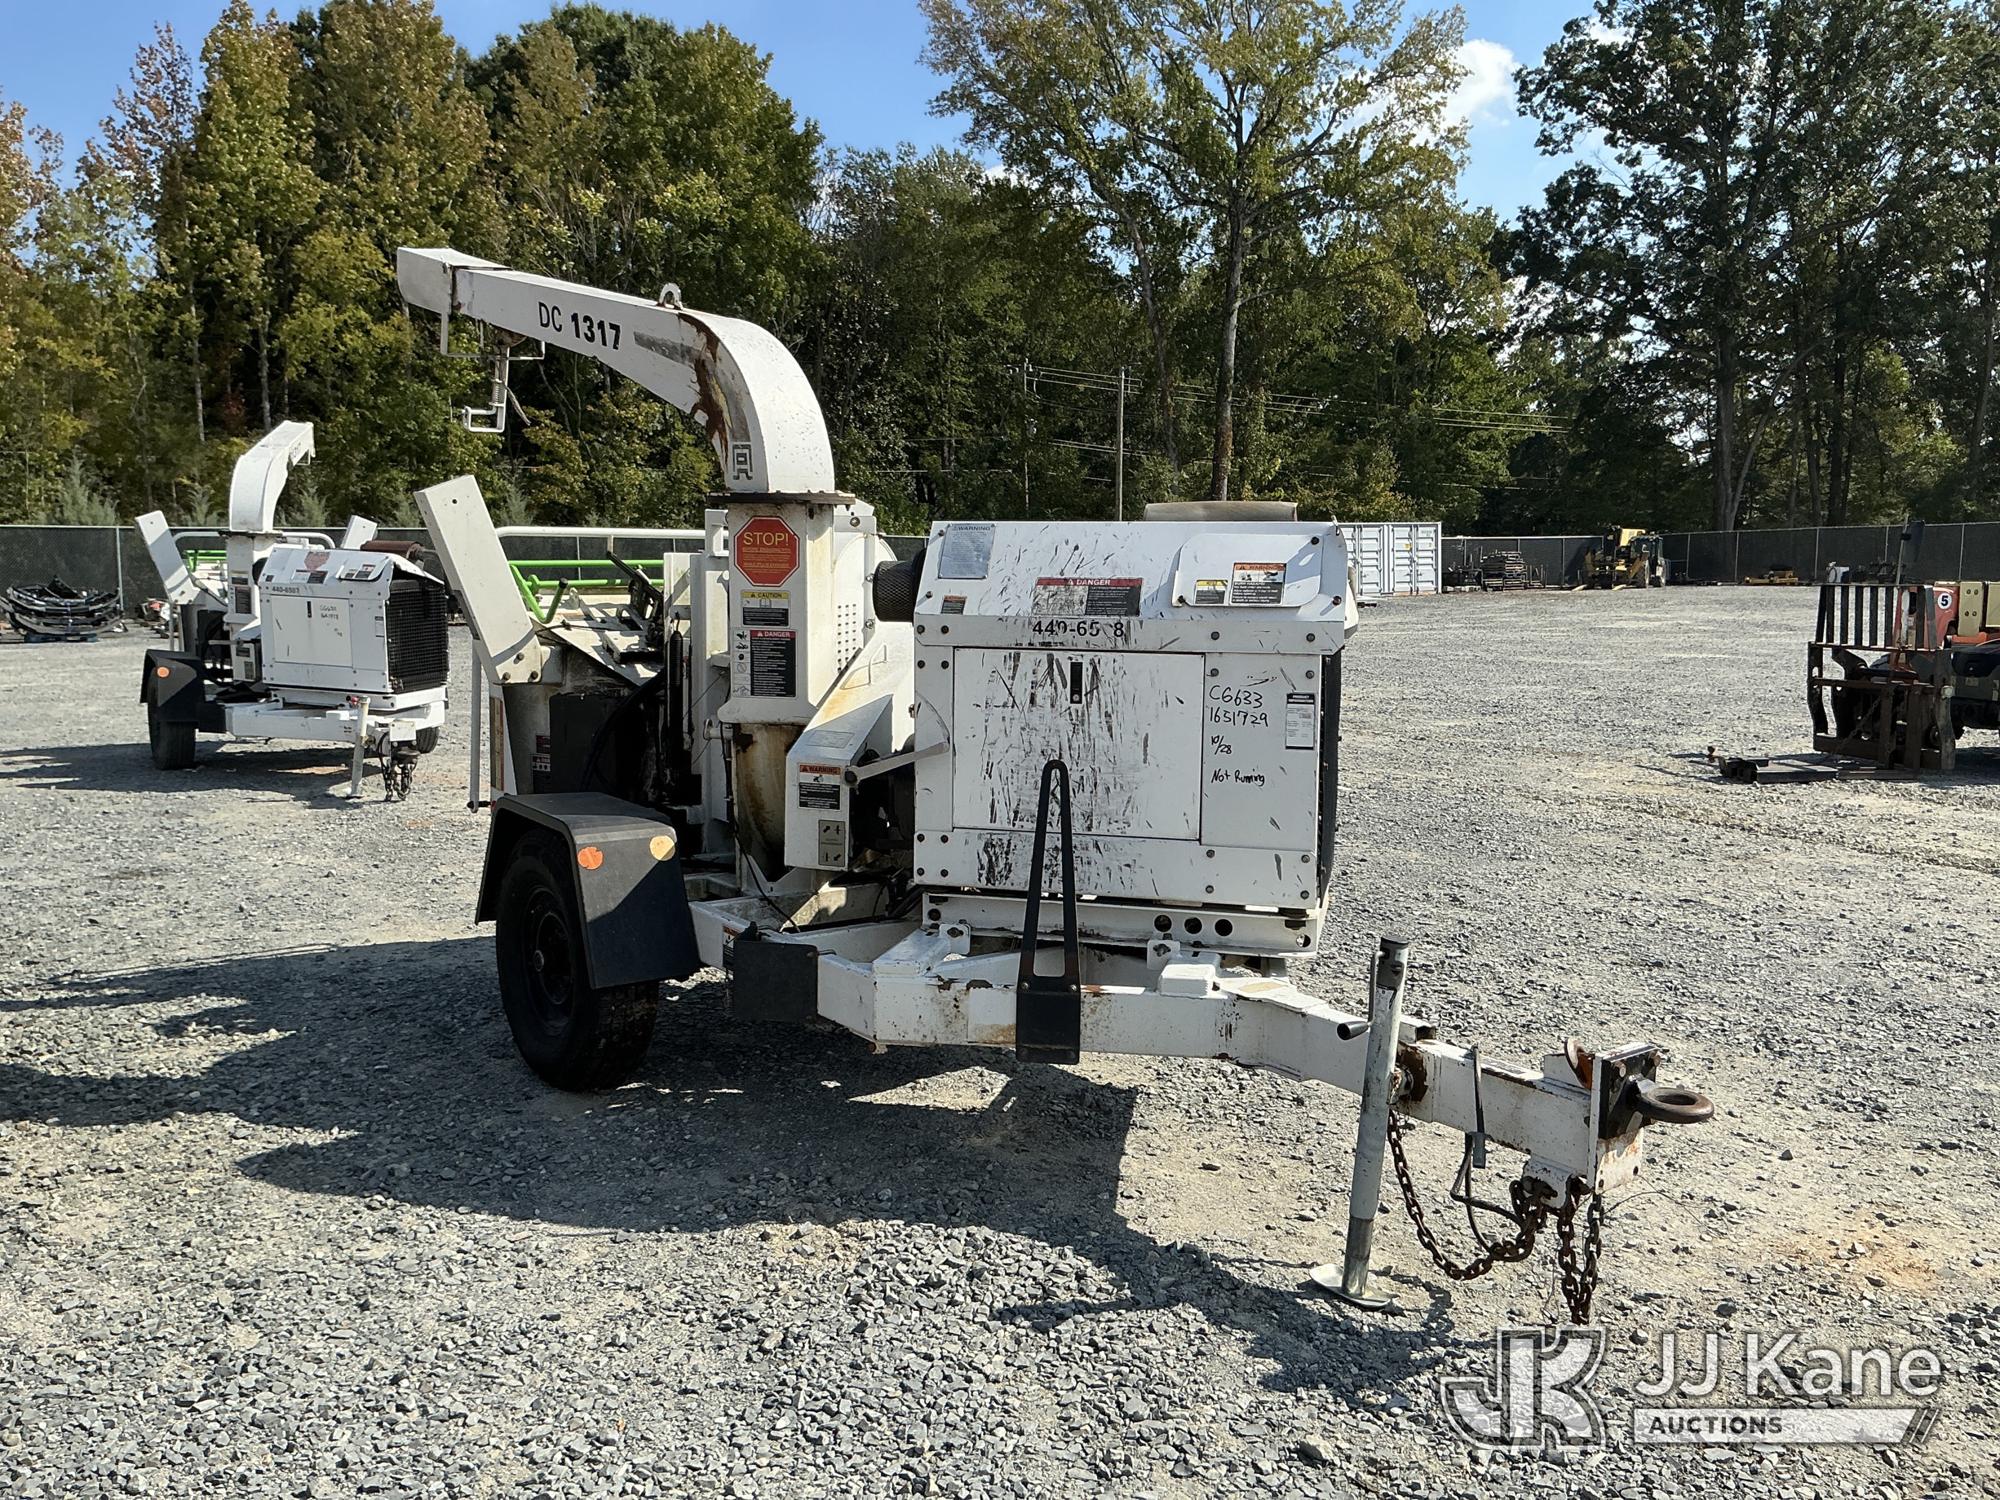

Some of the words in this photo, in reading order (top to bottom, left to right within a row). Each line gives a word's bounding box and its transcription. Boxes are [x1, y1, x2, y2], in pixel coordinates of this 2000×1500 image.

[538, 301, 562, 332] DC
[571, 312, 621, 350] 1317
[743, 532, 789, 546] STOP!
[1940, 595, 1950, 607] 5
[1211, 734, 1232, 755] 10/28
[1211, 768, 1231, 783] Not
